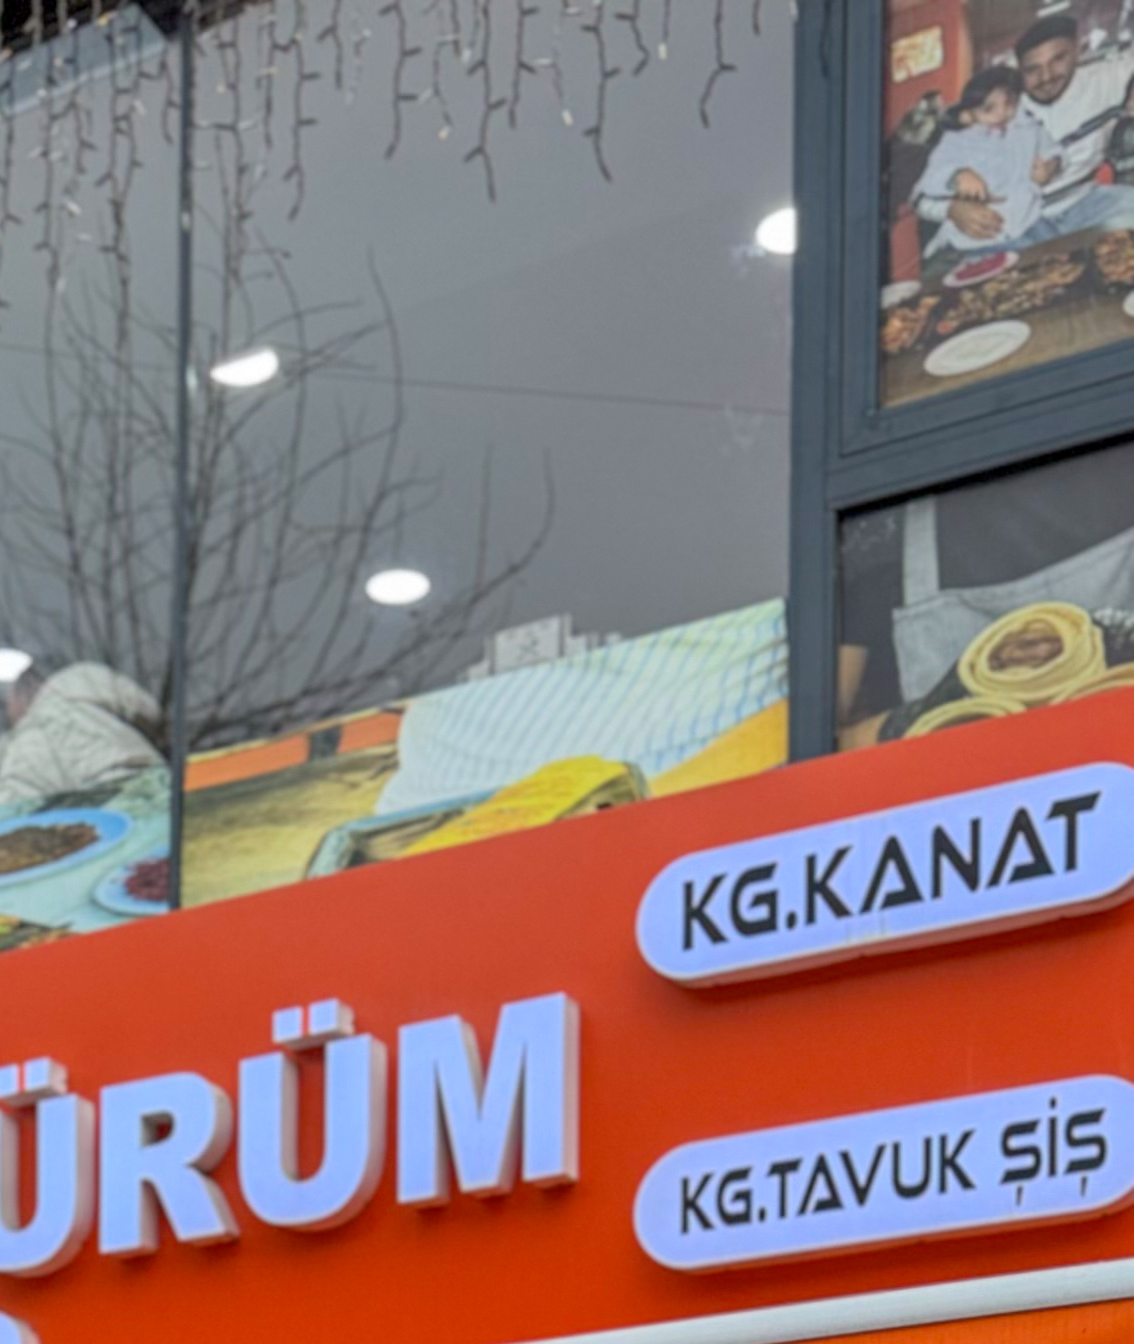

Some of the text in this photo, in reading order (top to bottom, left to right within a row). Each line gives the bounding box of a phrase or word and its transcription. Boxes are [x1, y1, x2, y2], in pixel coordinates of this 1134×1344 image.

[682, 790, 1102, 952] KG.KANAT
[679, 1095, 1108, 1236] KG.TAVUK ŞİŞ
